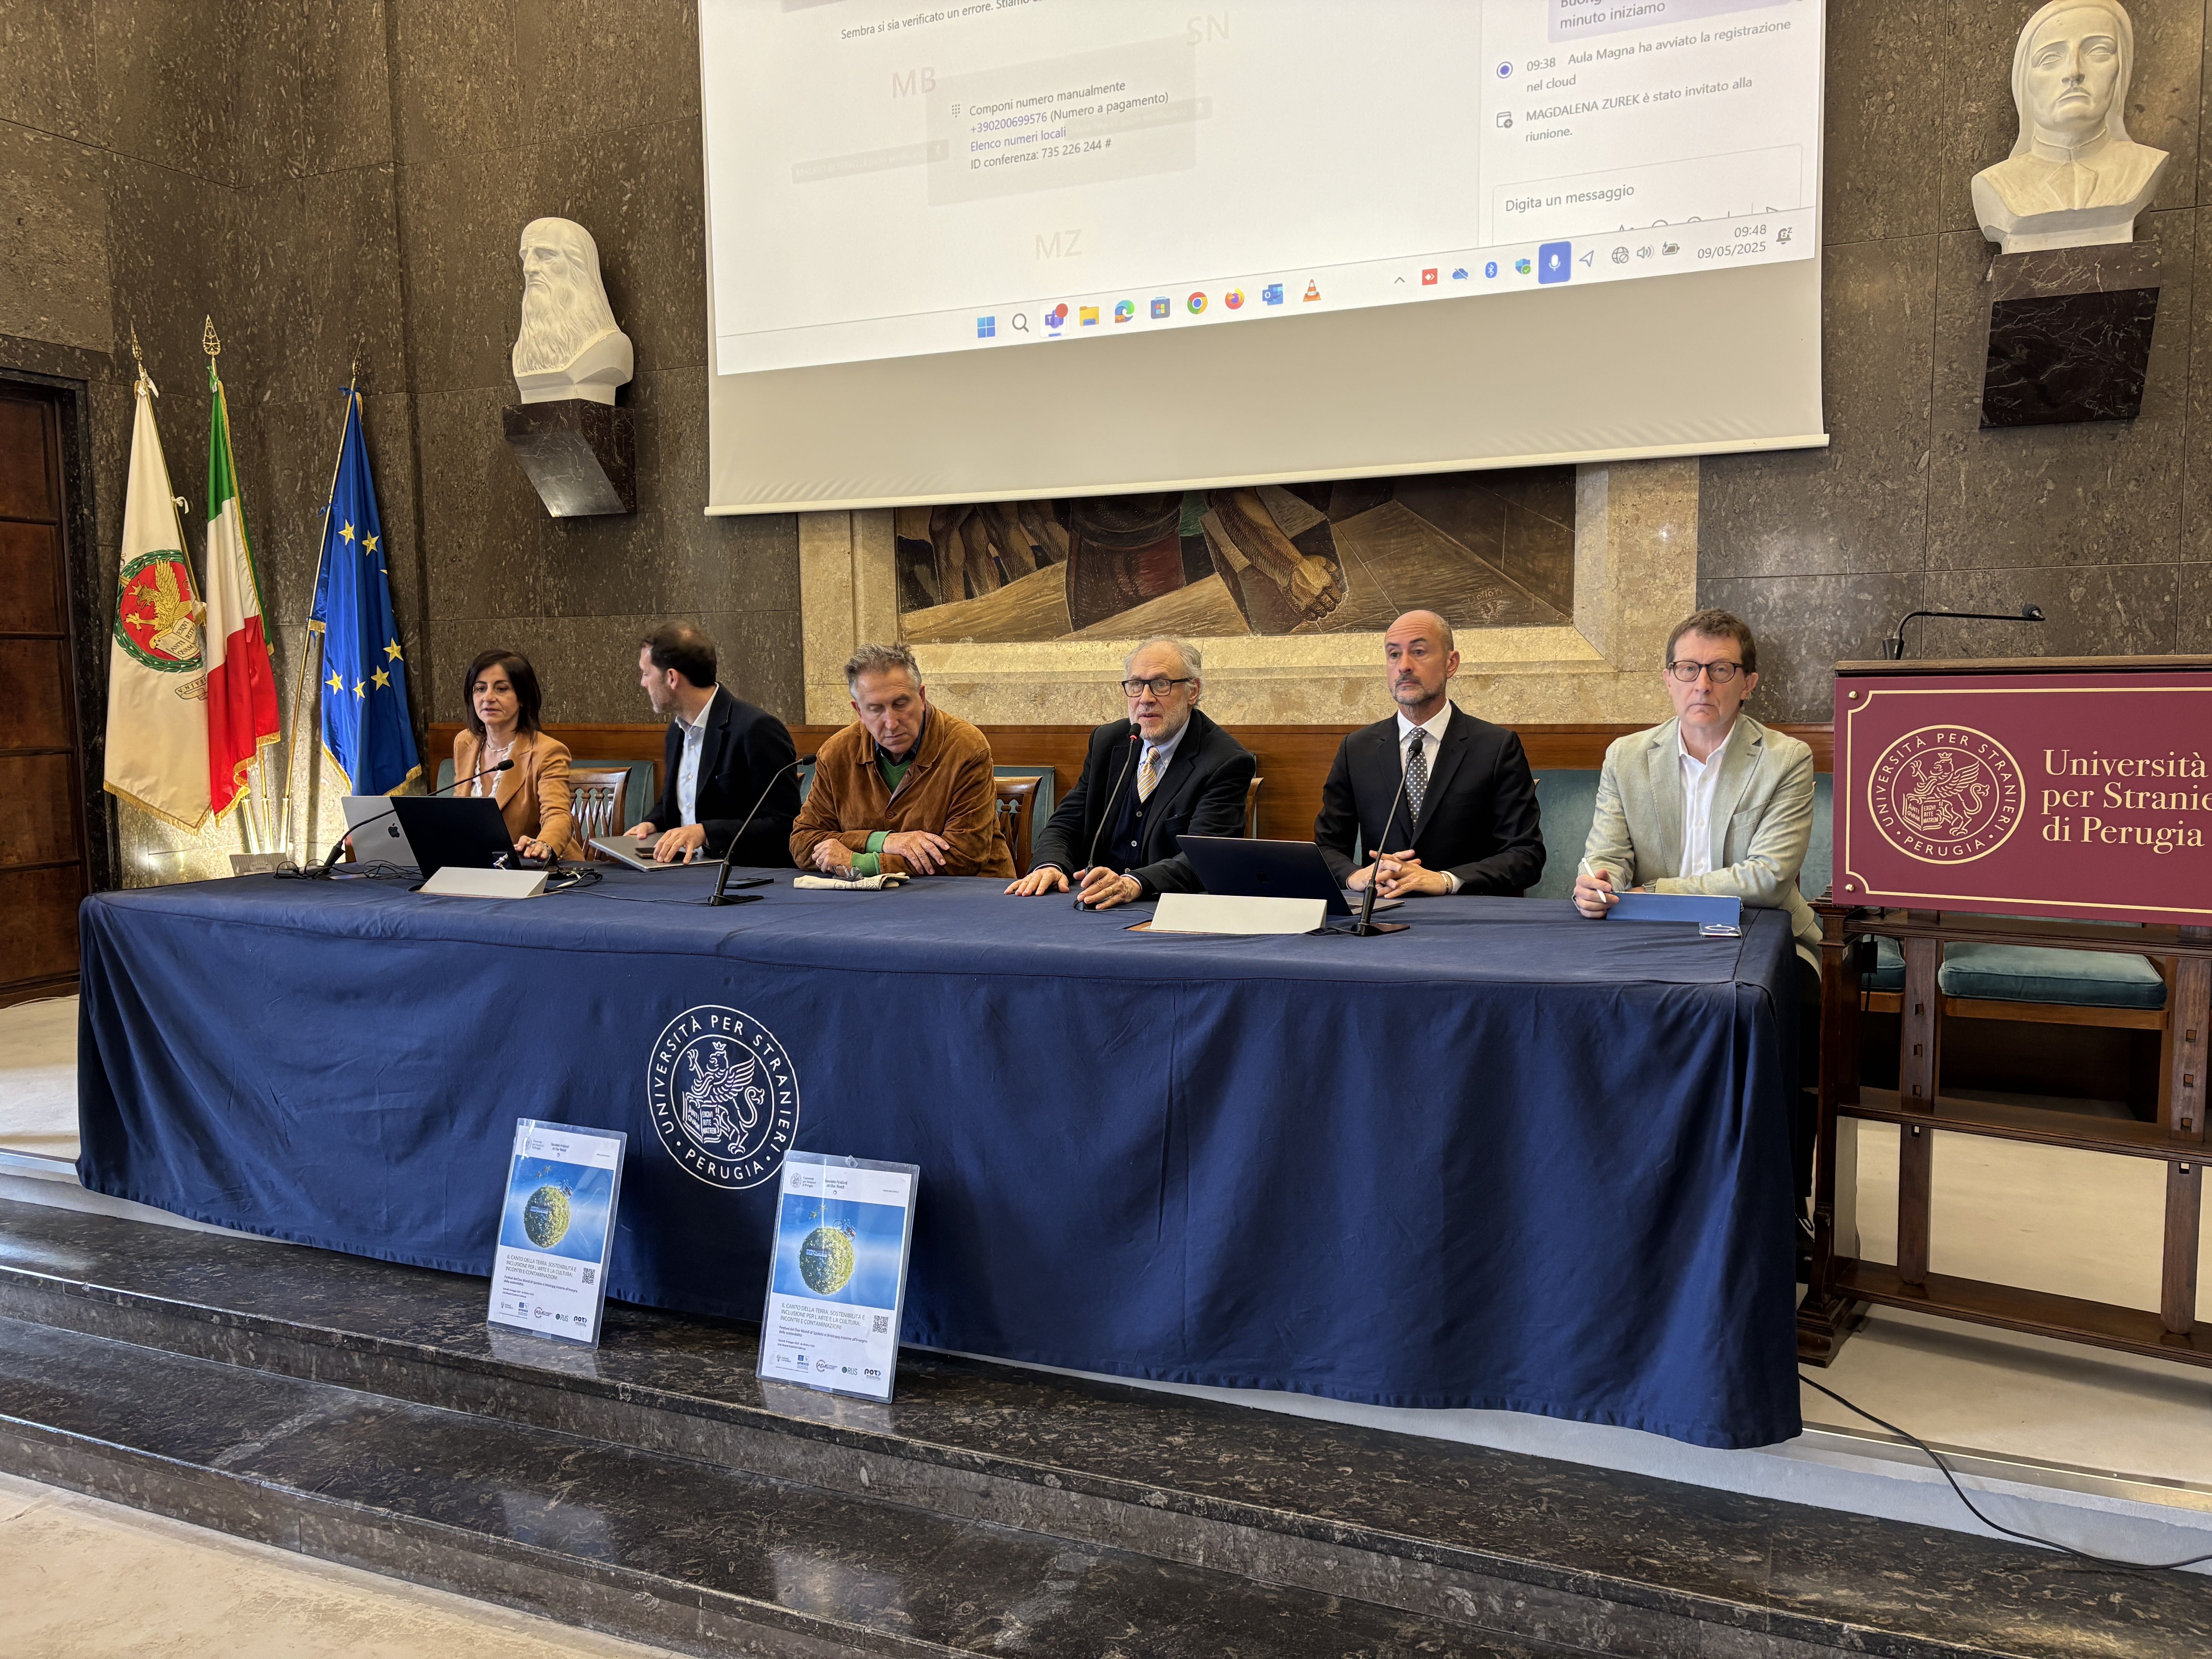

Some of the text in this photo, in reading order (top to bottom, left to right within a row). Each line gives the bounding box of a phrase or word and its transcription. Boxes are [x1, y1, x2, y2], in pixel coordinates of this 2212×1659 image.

[841, 25, 875, 39] Sembra
[878, 21, 885, 32] si
[887, 19, 899, 30] sia
[902, 12, 944, 27] verificato
[947, 9, 959, 19] un
[962, 3, 994, 15] errore.
[1187, 12, 1229, 46] SN
[1560, 2, 1665, 29] minuto iniziamo
[1527, 21, 1791, 71] 09:38 Aula Magna ha avviato la registrazione
[892, 66, 936, 98] MB
[1527, 74, 1576, 92] nel cloud
[969, 82, 1126, 116] Componi numero manualmente
[970, 112, 1047, 133] +390200699576
[1050, 105, 1094, 123] (Numero
[1097, 105, 1103, 113] a
[1106, 91, 1169, 115] pagamento)
[1526, 77, 1752, 122] MAGDALENA ZUREK è stato invitato alla
[971, 126, 1066, 152] Elenco numeri locali
[1525, 127, 1573, 142] riunione.
[971, 137, 1112, 170] ID conferenza: 735 226 244 #
[1506, 184, 1635, 213] Digita un messaggio
[1036, 228, 1082, 261] MZ
[1735, 224, 1767, 238] 09:48
[1697, 241, 1766, 259] 09/05/2025
[176, 620, 189, 635] EXQVI
[170, 640, 185, 651] ANTI
[2043, 749, 2209, 778] Università
[1876, 733, 2016, 831] UNIVERSITÀ PER STRANIERI
[1908, 803, 1919, 814] ANTI
[2040, 781, 2212, 815] per Stranie
[1904, 836, 1985, 856] PERUGIA
[2042, 816, 2205, 854] di Perugia
[654, 1015, 792, 1153] UNIVERSITÀ PER STRANIERI
[688, 1105, 699, 1121] ANTI
[685, 1148, 764, 1180] PERUGIA
[526, 1269, 557, 1280] CONTAMINAZIONI
[781, 1309, 805, 1317] INCLUSIONE
[804, 1319, 842, 1329] CONTAMINAZIONI
[830, 1310, 861, 1319] SOSTENIBILITÀ
[847, 1367, 858, 1375] RUS
